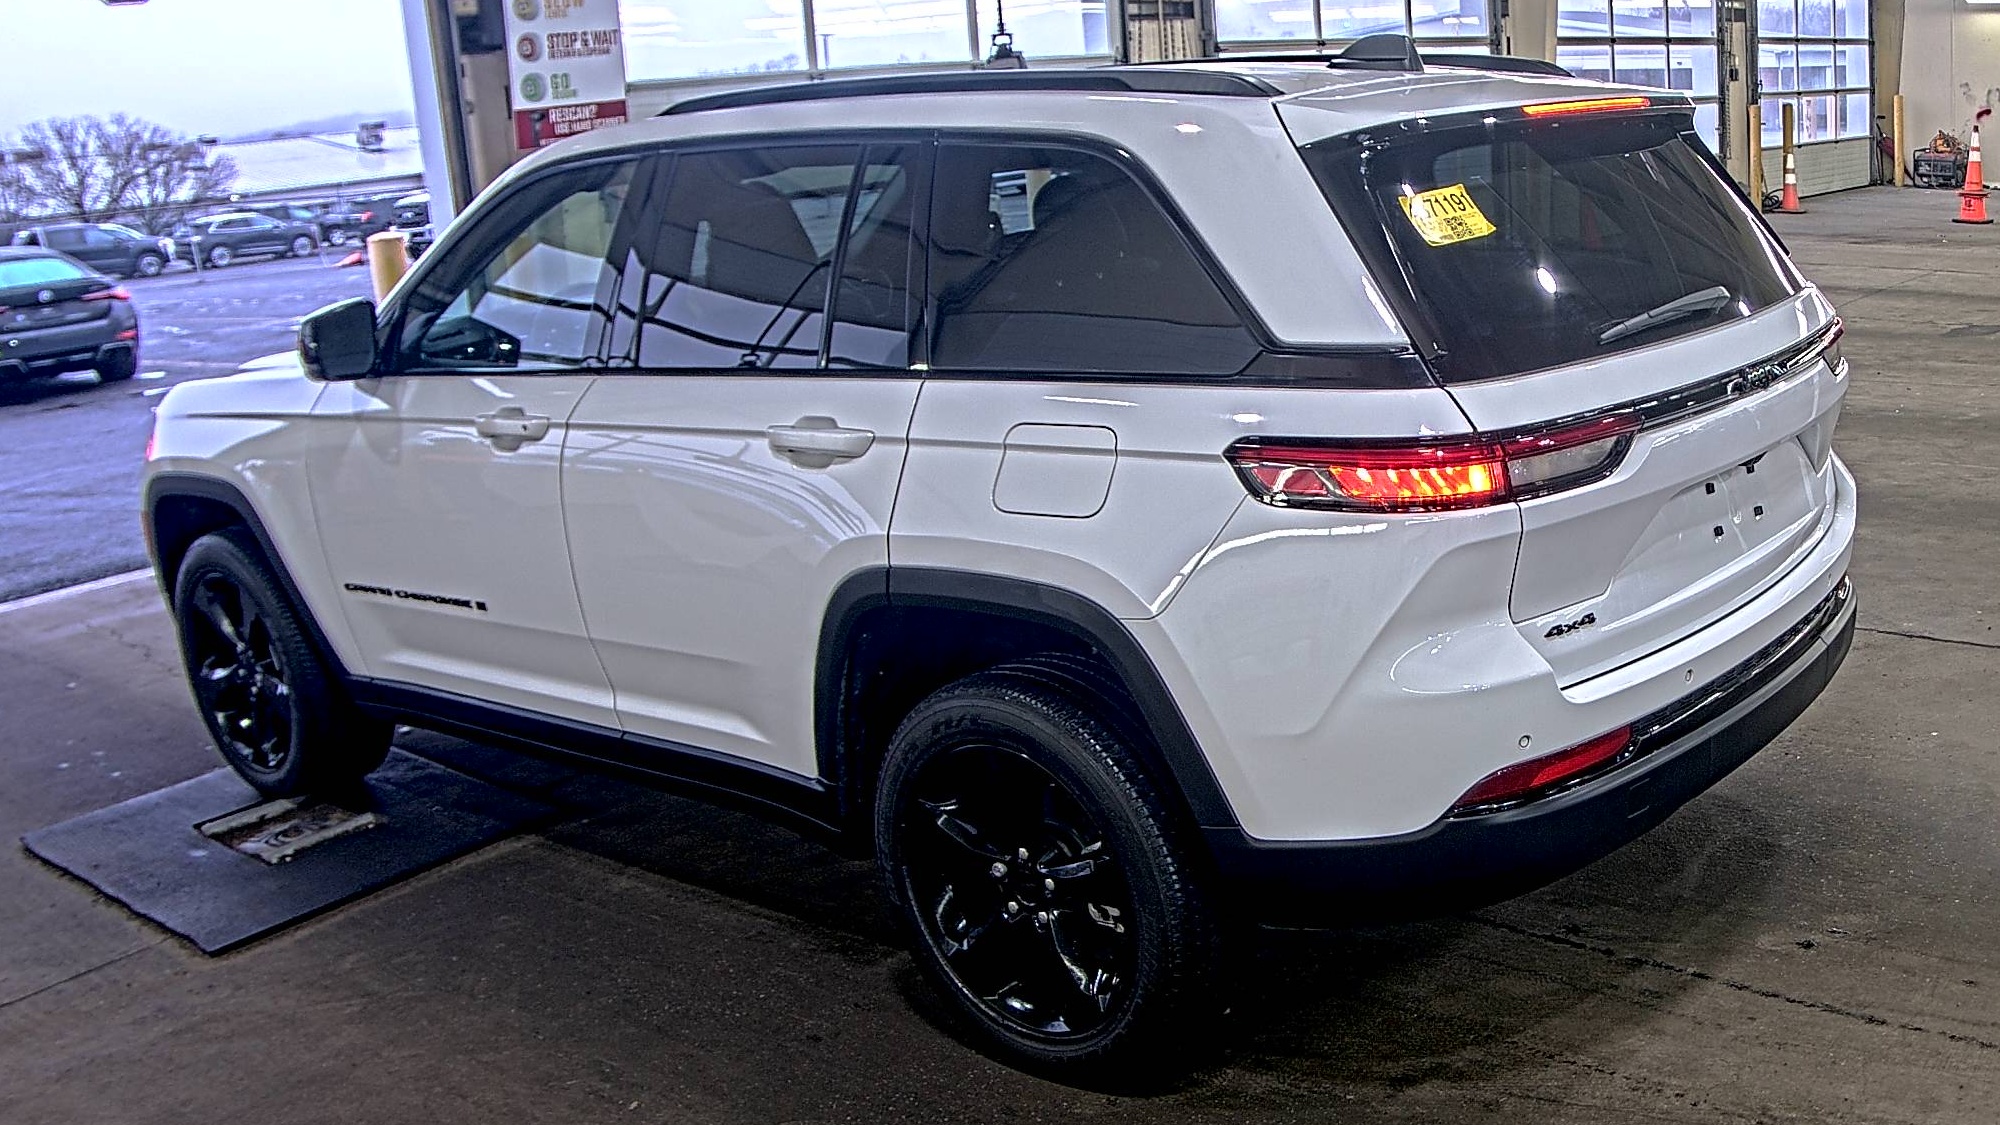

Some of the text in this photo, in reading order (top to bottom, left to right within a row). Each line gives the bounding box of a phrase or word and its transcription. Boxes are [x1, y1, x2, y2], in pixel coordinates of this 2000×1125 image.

[547, 32, 578, 49] STOP
[590, 28, 618, 46] WAIT
[550, 72, 570, 90] GO
